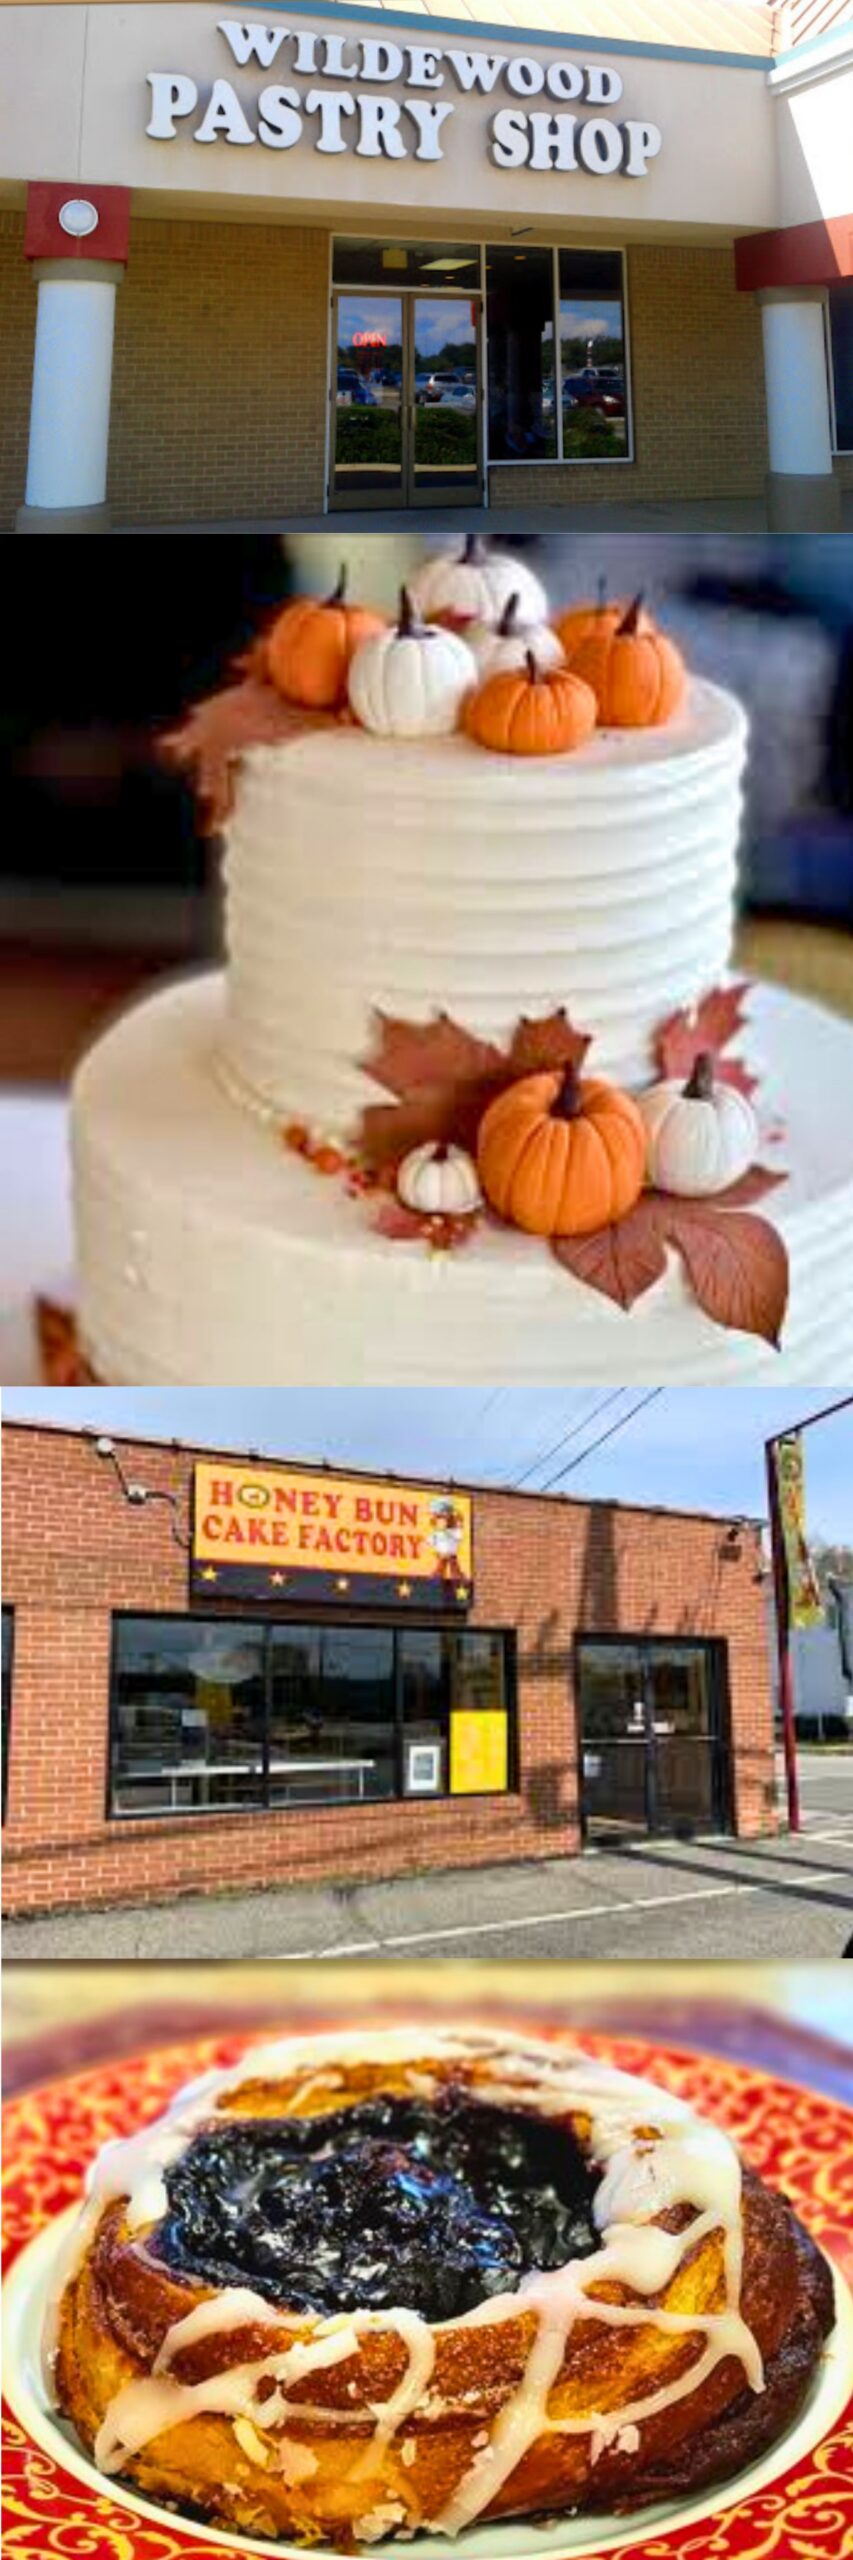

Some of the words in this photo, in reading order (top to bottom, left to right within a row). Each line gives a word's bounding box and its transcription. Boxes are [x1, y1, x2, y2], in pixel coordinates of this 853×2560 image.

[216, 20, 624, 105] WILDEWOOD
[145, 72, 455, 161] PASTRY
[489, 108, 663, 177] SHOP
[352, 331, 388, 347] OPEN
[209, 1480, 342, 1519] HONEY
[355, 1497, 418, 1528] BUN
[201, 1514, 289, 1547] CAKE
[298, 1524, 424, 1559] FACTORY
